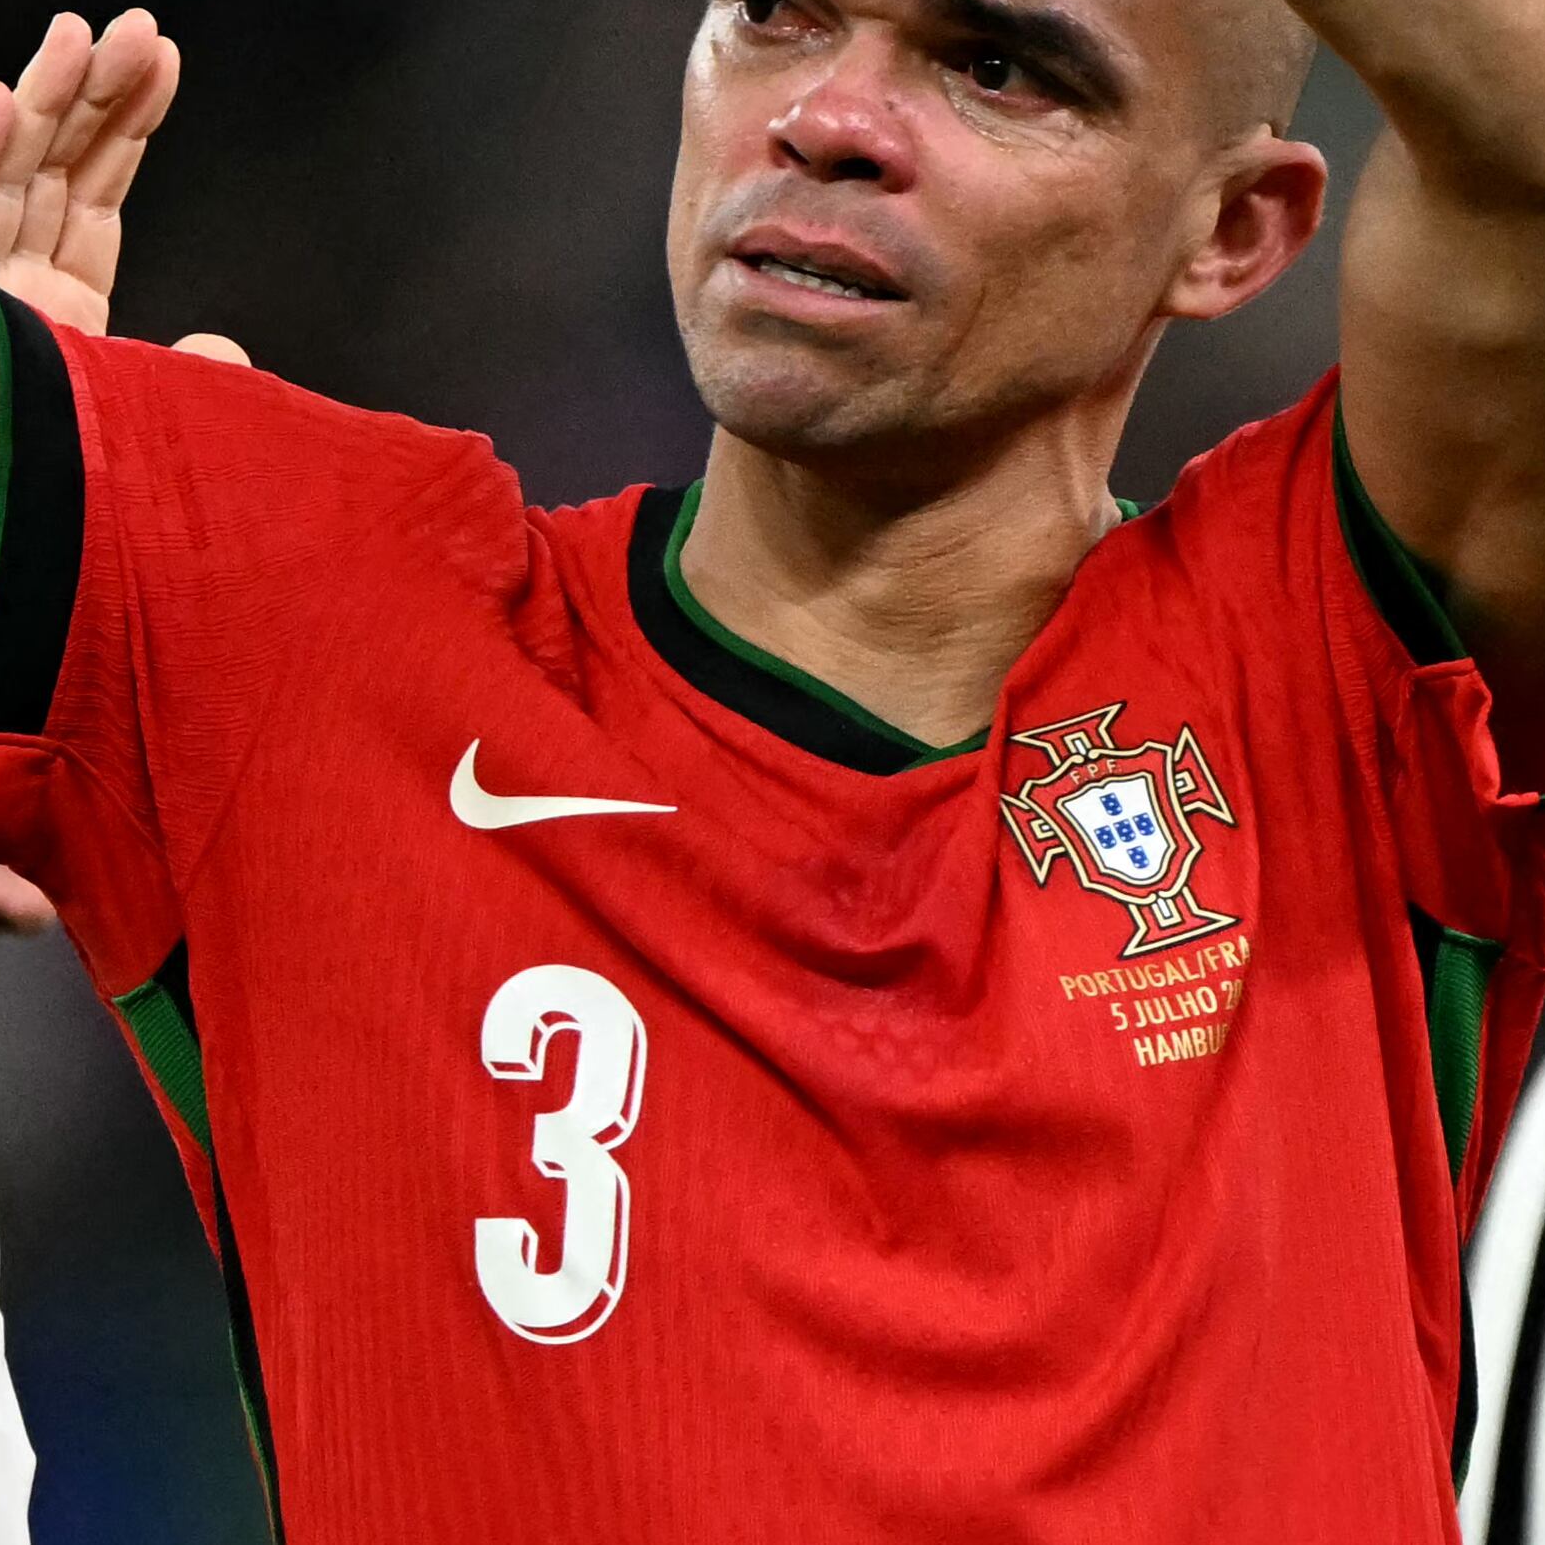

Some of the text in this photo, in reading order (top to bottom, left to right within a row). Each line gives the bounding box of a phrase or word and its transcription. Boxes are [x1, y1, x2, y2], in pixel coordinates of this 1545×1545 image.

[1111, 1002, 1129, 1031] 5
[1134, 986, 1218, 1028] JULHO
[474, 964, 648, 1344] 3
